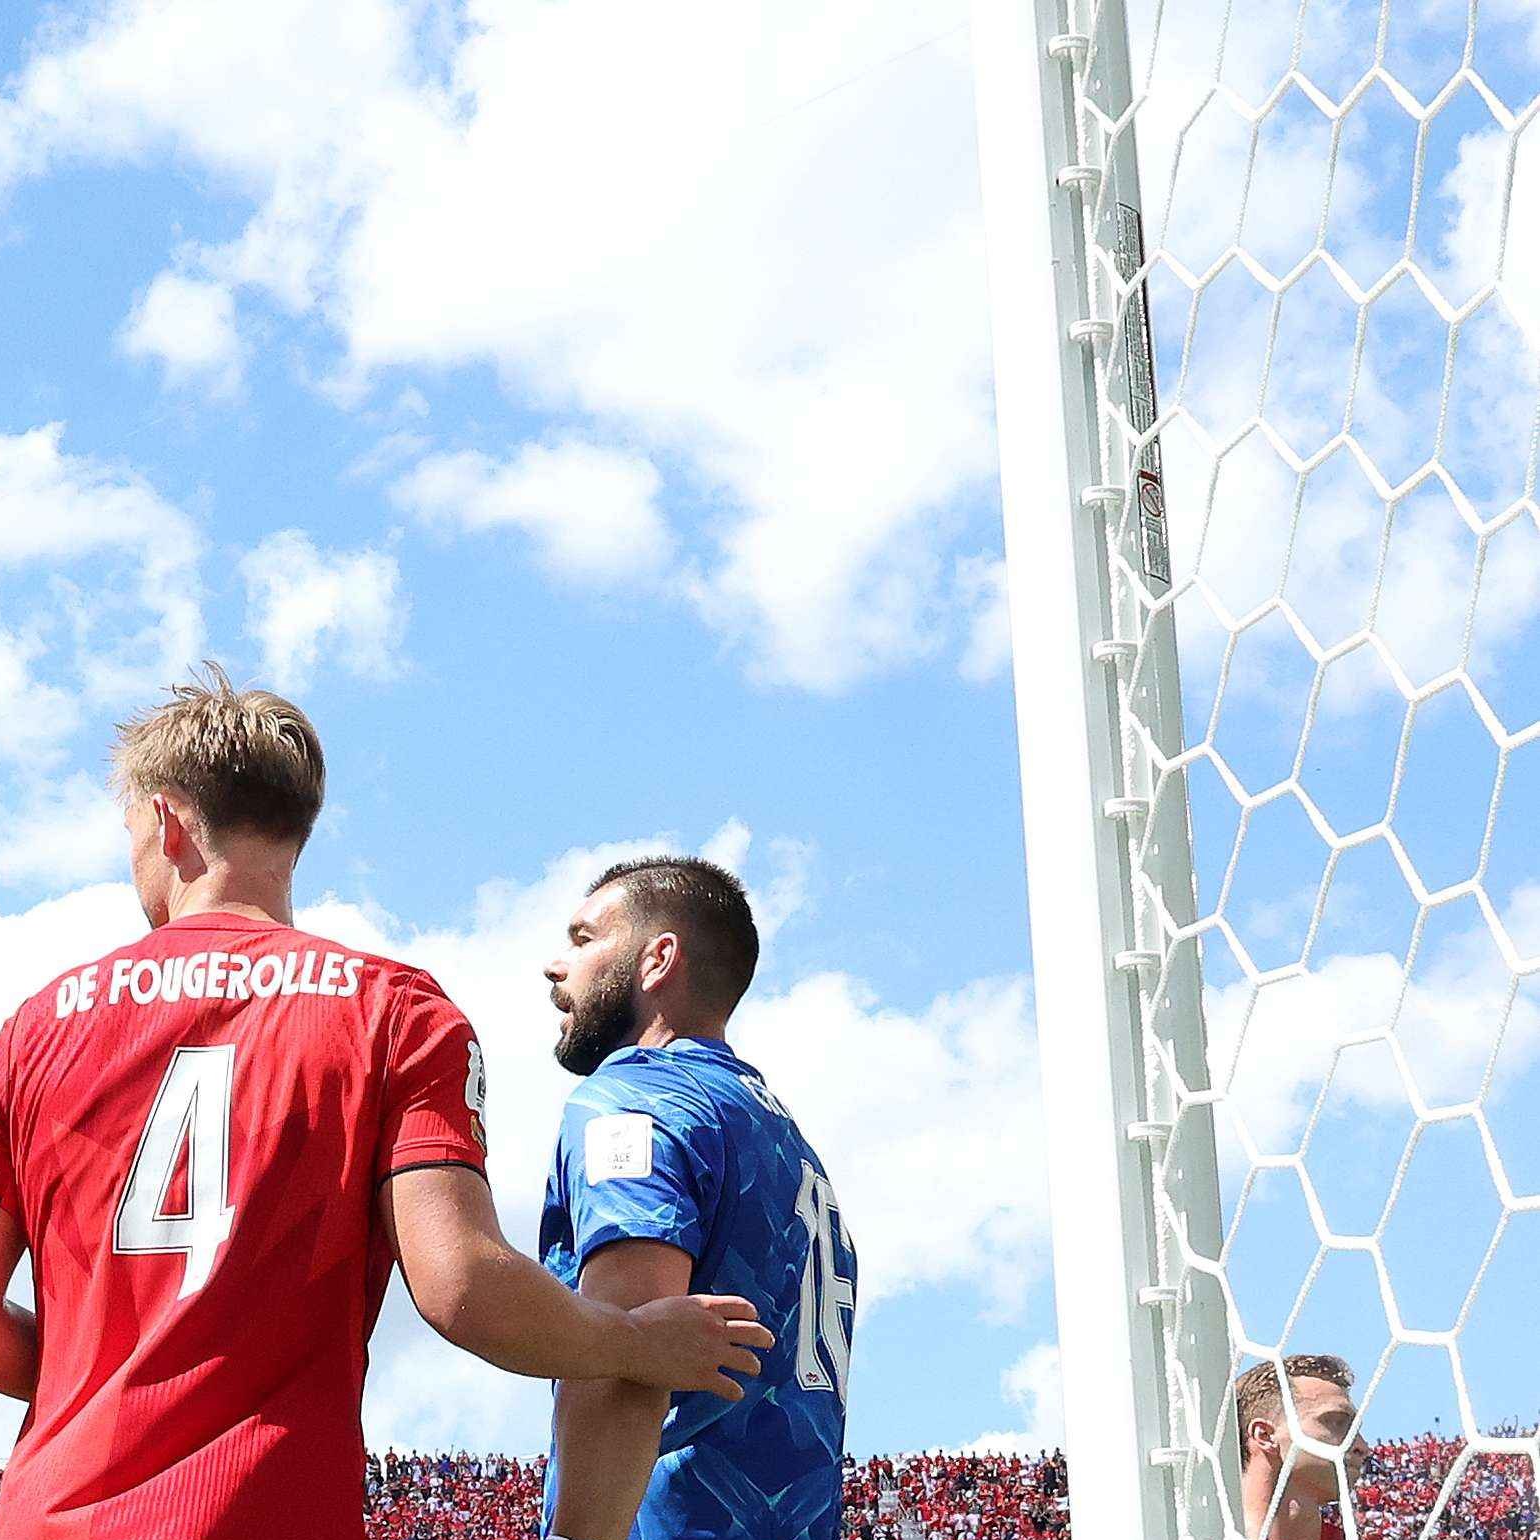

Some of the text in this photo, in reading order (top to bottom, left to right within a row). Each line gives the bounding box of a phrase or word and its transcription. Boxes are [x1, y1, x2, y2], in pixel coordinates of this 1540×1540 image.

[55, 950, 365, 1019] DE FOUGEROLLES
[113, 1043, 236, 1301] 4
